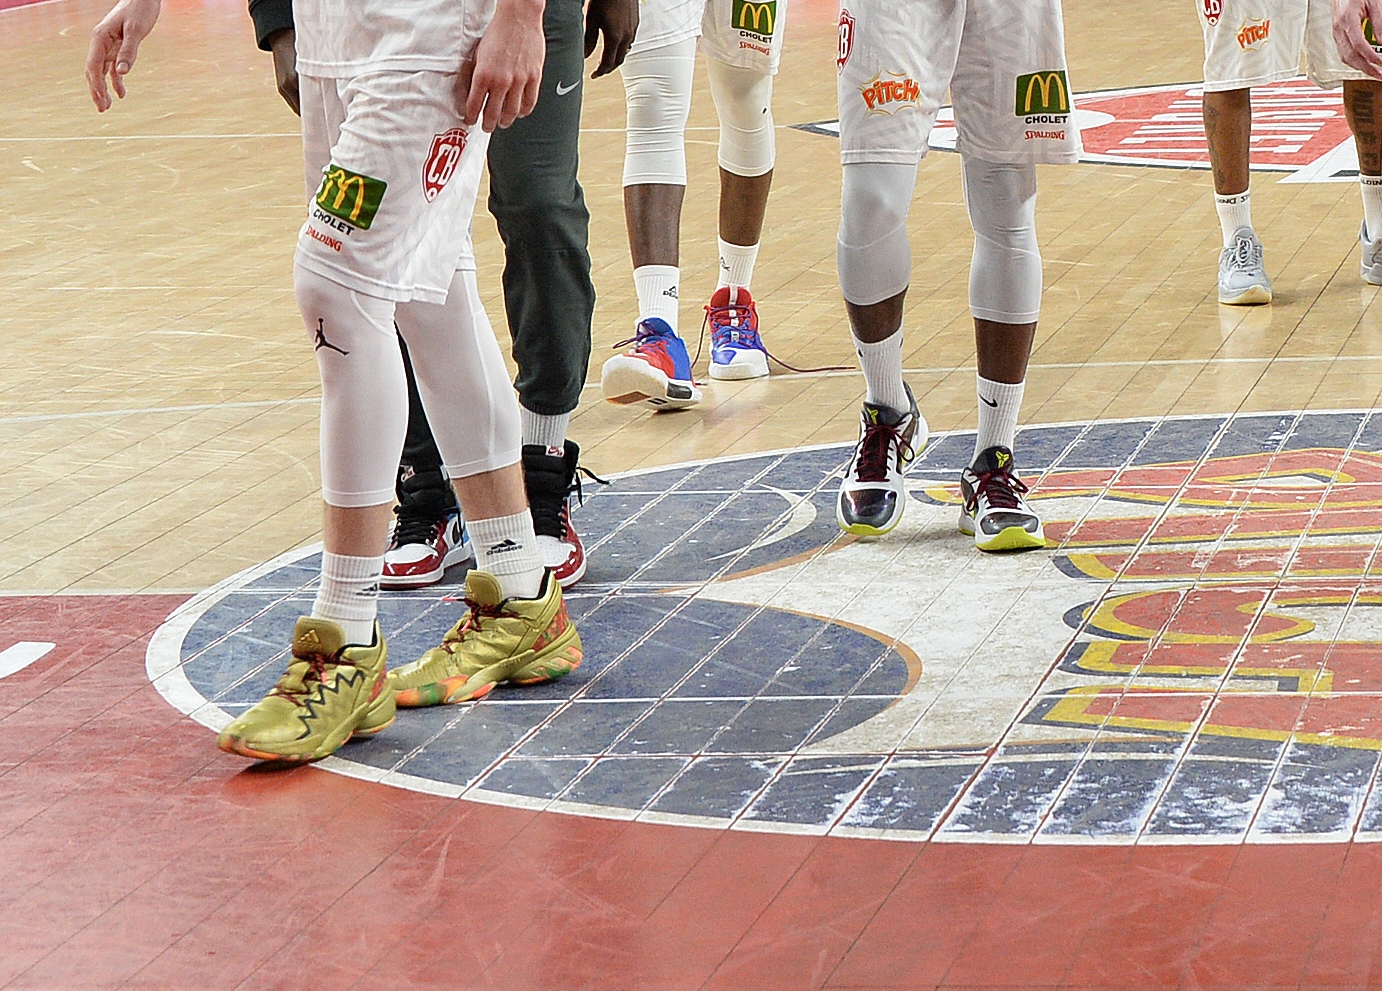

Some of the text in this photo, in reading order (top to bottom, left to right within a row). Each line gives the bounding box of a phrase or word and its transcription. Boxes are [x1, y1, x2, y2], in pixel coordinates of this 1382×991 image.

[739, 30, 773, 44] CHOLET
[1024, 115, 1068, 124] CHOLET
[1024, 130, 1065, 140] SPALDING
[427, 143, 461, 187] CB
[313, 208, 355, 236] CHOLET
[305, 225, 343, 253] PALDING
